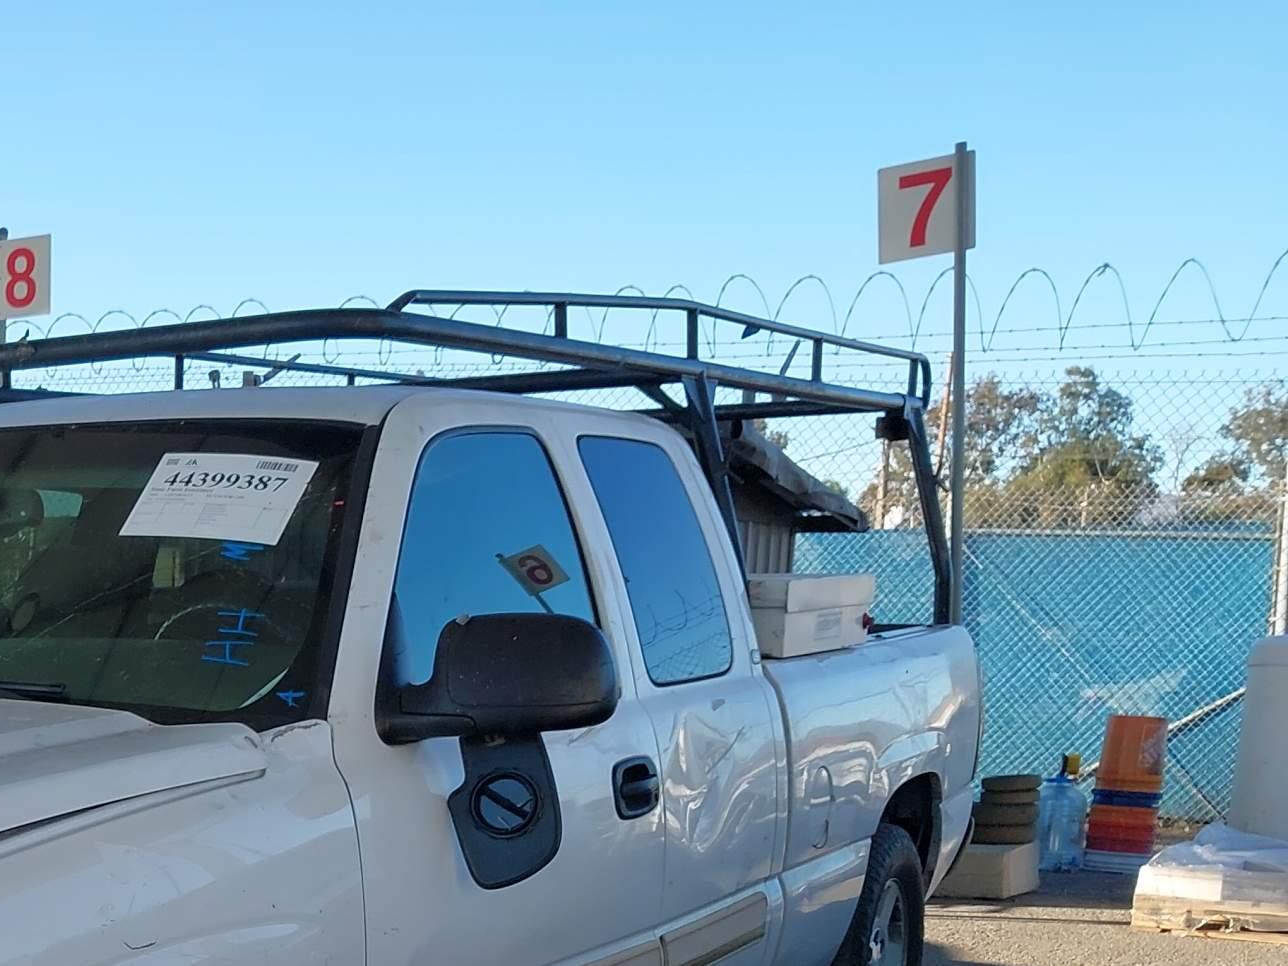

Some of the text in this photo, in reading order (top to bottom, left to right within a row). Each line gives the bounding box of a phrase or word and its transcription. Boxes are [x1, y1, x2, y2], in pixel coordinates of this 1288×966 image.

[899, 168, 952, 247] 7
[5, 247, 36, 308] 8
[163, 470, 288, 493] 44399387
